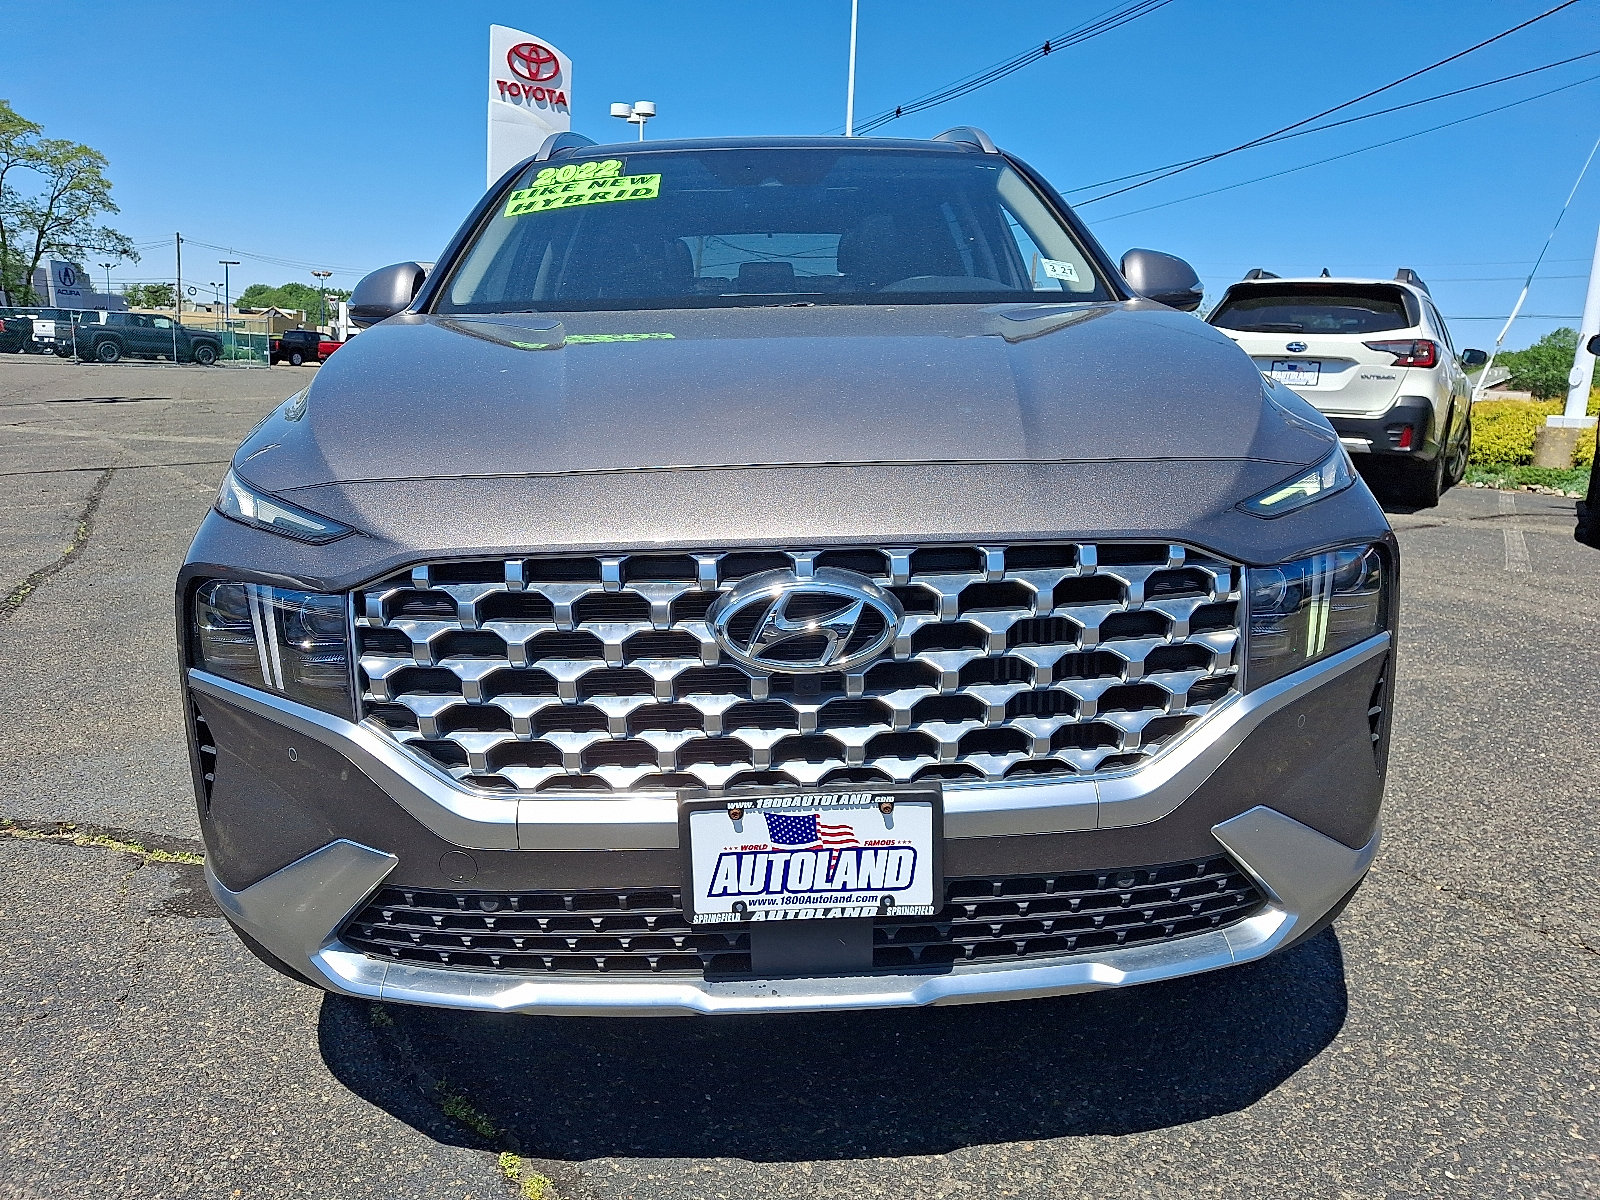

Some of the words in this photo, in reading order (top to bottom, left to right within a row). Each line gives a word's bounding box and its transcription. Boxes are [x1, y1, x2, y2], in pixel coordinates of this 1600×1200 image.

[496, 80, 567, 107] TOYOTA
[531, 159, 623, 187] 2022
[511, 184, 578, 201] LIKE
[587, 175, 655, 191] NEW
[511, 187, 655, 213] HYBRID
[727, 793, 895, 808] www.1800AUTOLAND.com
[740, 844, 768, 852] WORLD
[864, 839, 895, 847] FAMOUS
[707, 846, 917, 898] AUTOLAND
[748, 894, 878, 907] www.1800Autoland.com
[693, 912, 742, 925] SPRINGFIELD
[751, 907, 878, 921] AUTOLAND
[886, 906, 935, 916] SPRINGFIELD
